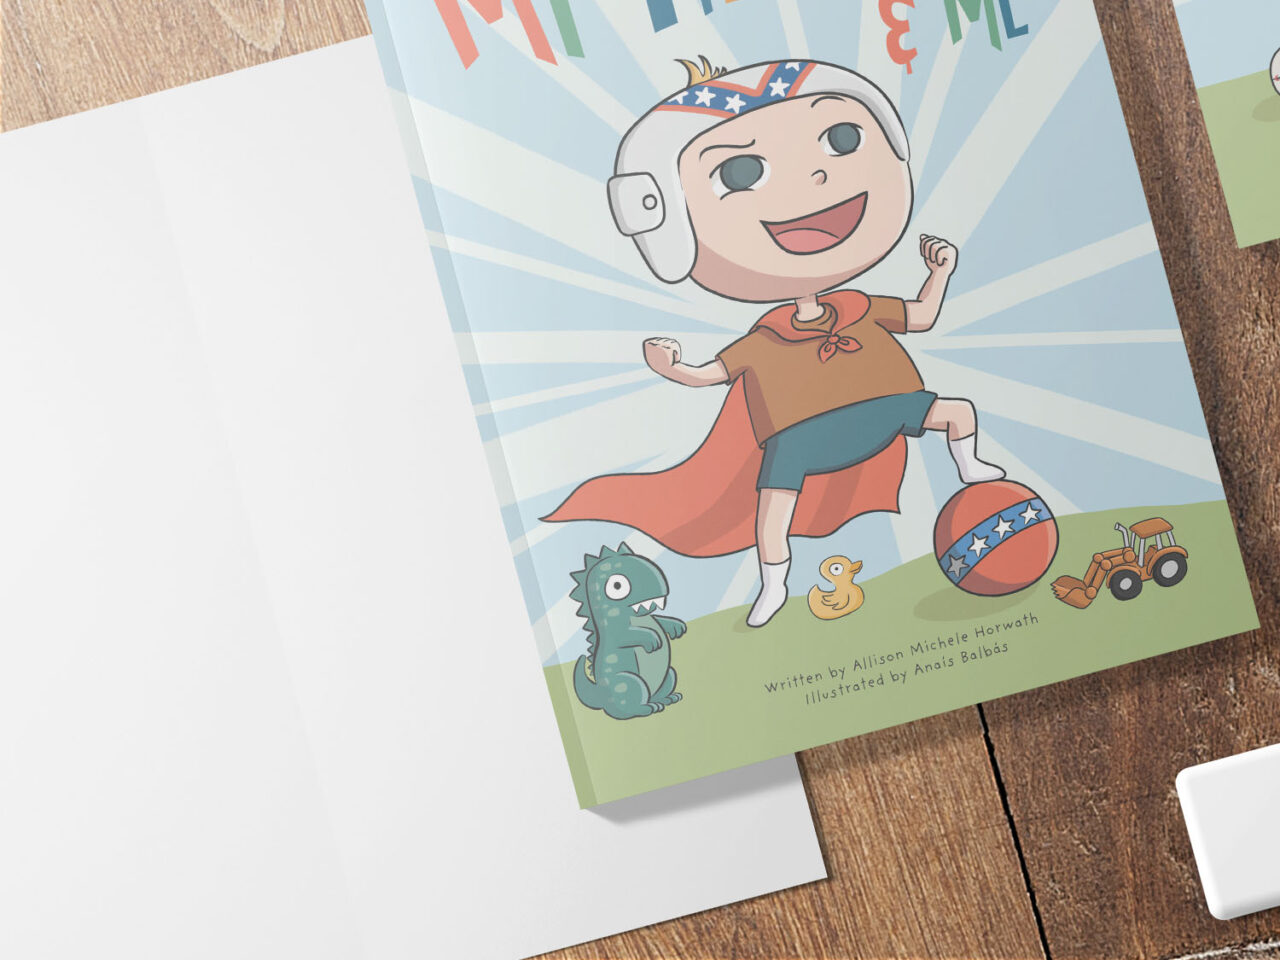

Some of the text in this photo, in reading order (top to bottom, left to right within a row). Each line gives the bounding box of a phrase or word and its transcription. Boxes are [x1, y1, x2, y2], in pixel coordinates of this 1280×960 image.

[764, 611, 1039, 693] Written by Allison Michele Horwath
[805, 672, 885, 705] Illustrated
[888, 669, 907, 684] by
[960, 641, 1009, 664] Balbás
